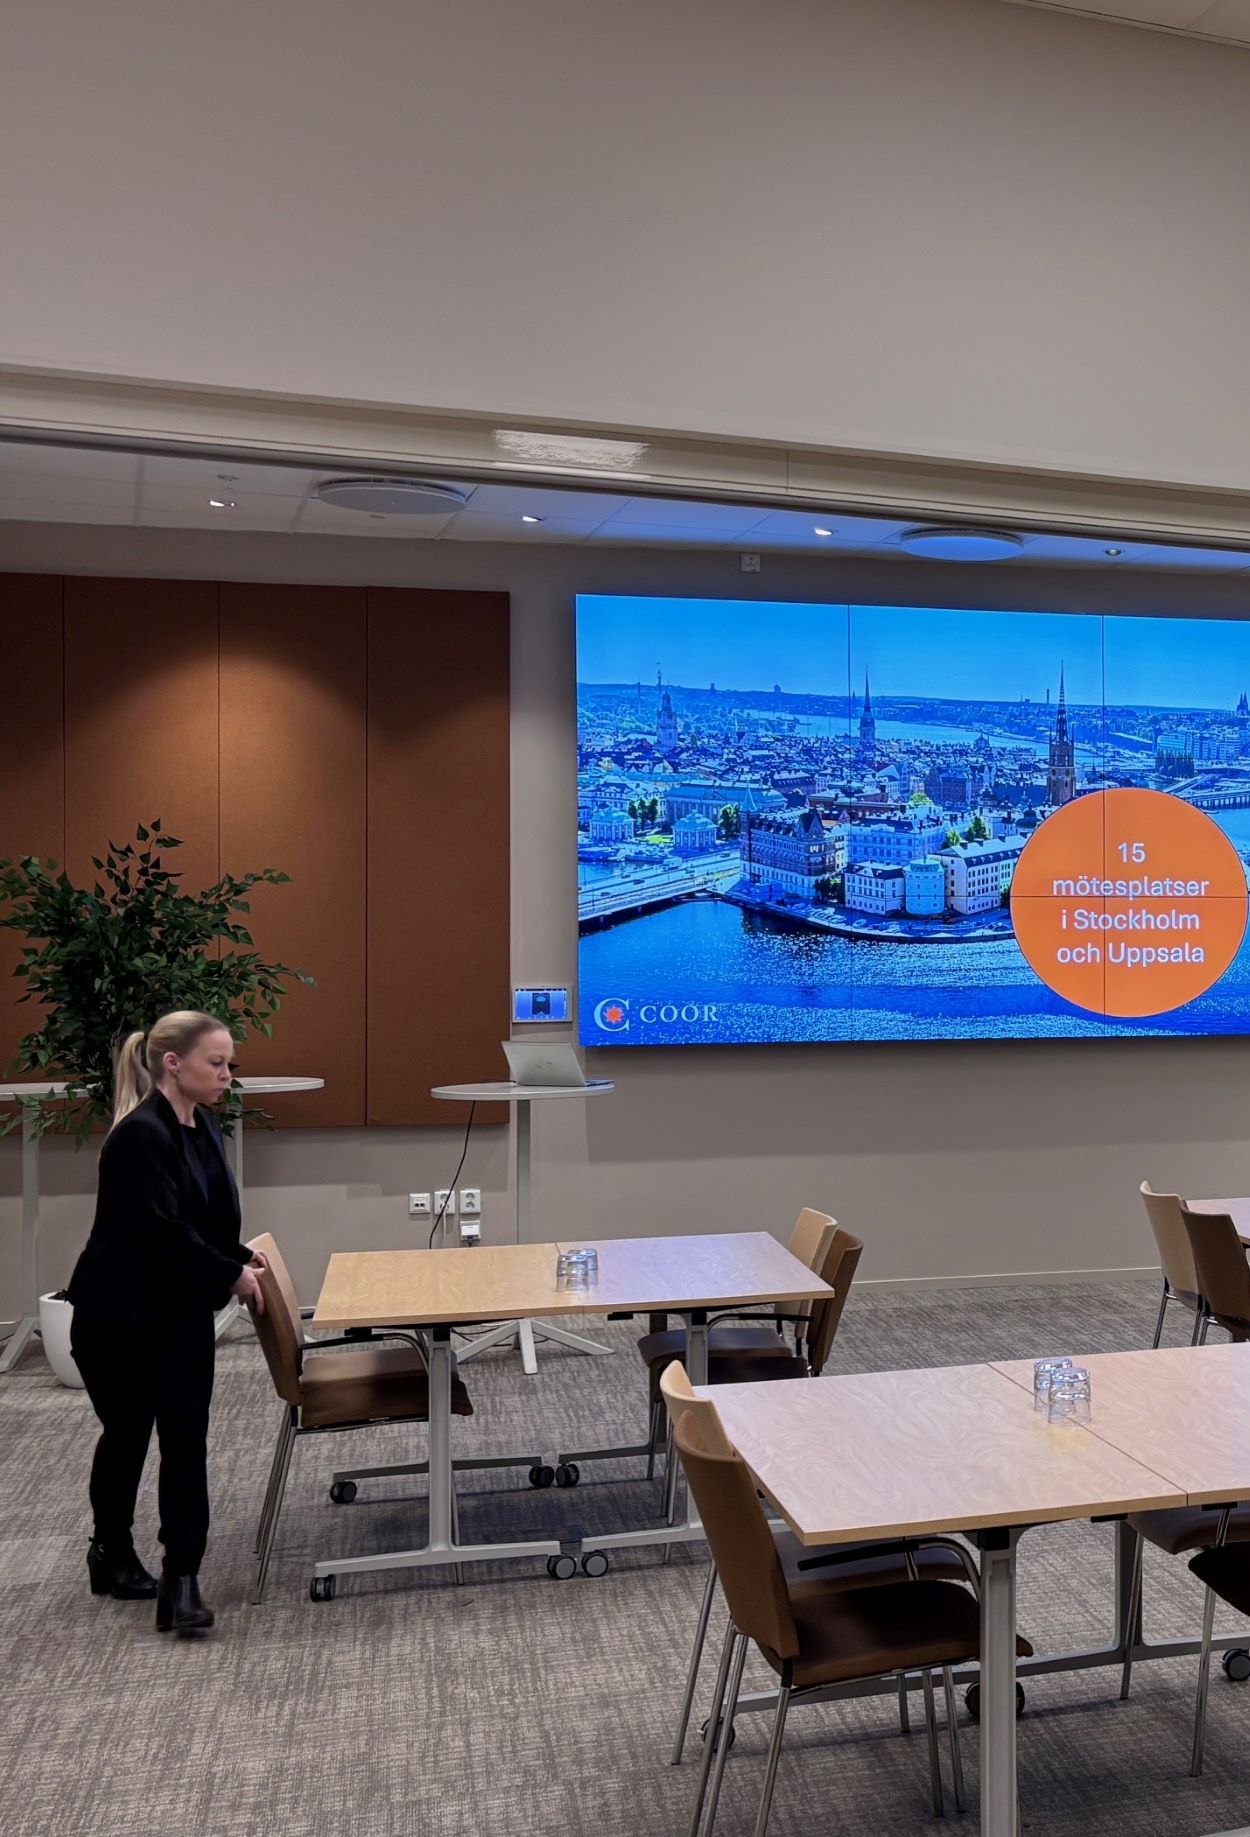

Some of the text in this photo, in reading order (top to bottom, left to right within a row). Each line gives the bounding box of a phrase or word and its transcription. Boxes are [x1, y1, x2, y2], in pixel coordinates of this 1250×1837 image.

[1118, 843, 1146, 863] 15
[1053, 876, 1210, 901] mötesplatser
[1061, 909, 1200, 930] i Stockholm
[1057, 942, 1204, 967] och Uppsala
[640, 1004, 718, 1023] COOR
